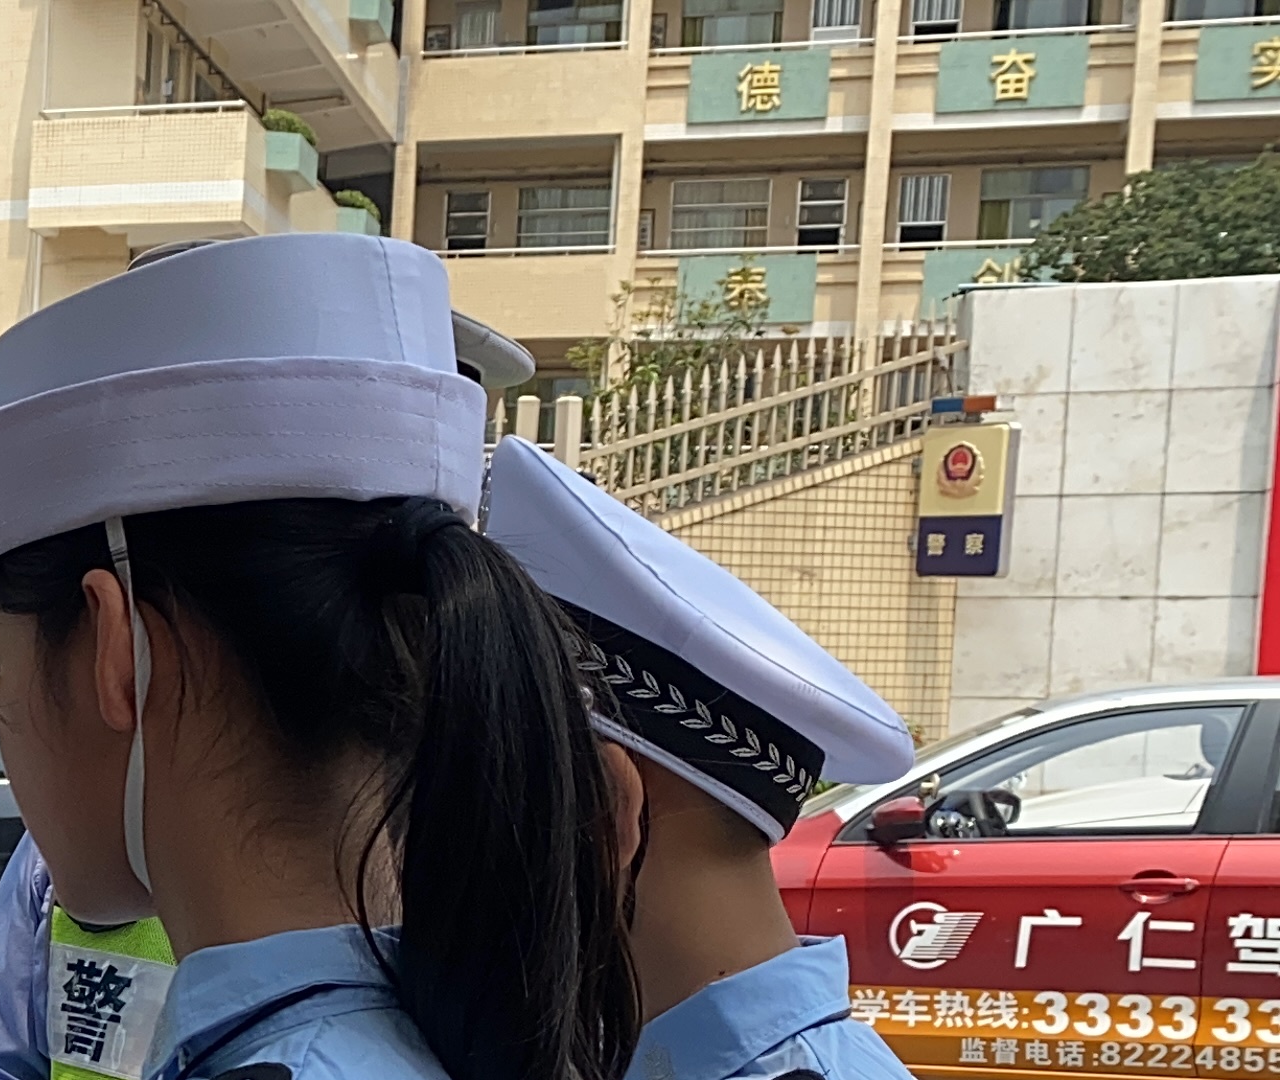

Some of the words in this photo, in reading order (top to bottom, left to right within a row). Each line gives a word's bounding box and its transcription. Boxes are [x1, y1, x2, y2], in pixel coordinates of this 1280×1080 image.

[737, 60, 782, 112] 德
[989, 48, 1038, 103] 奋
[1014, 909, 1280, 974] 广仁驾
[61, 958, 133, 1062] 警
